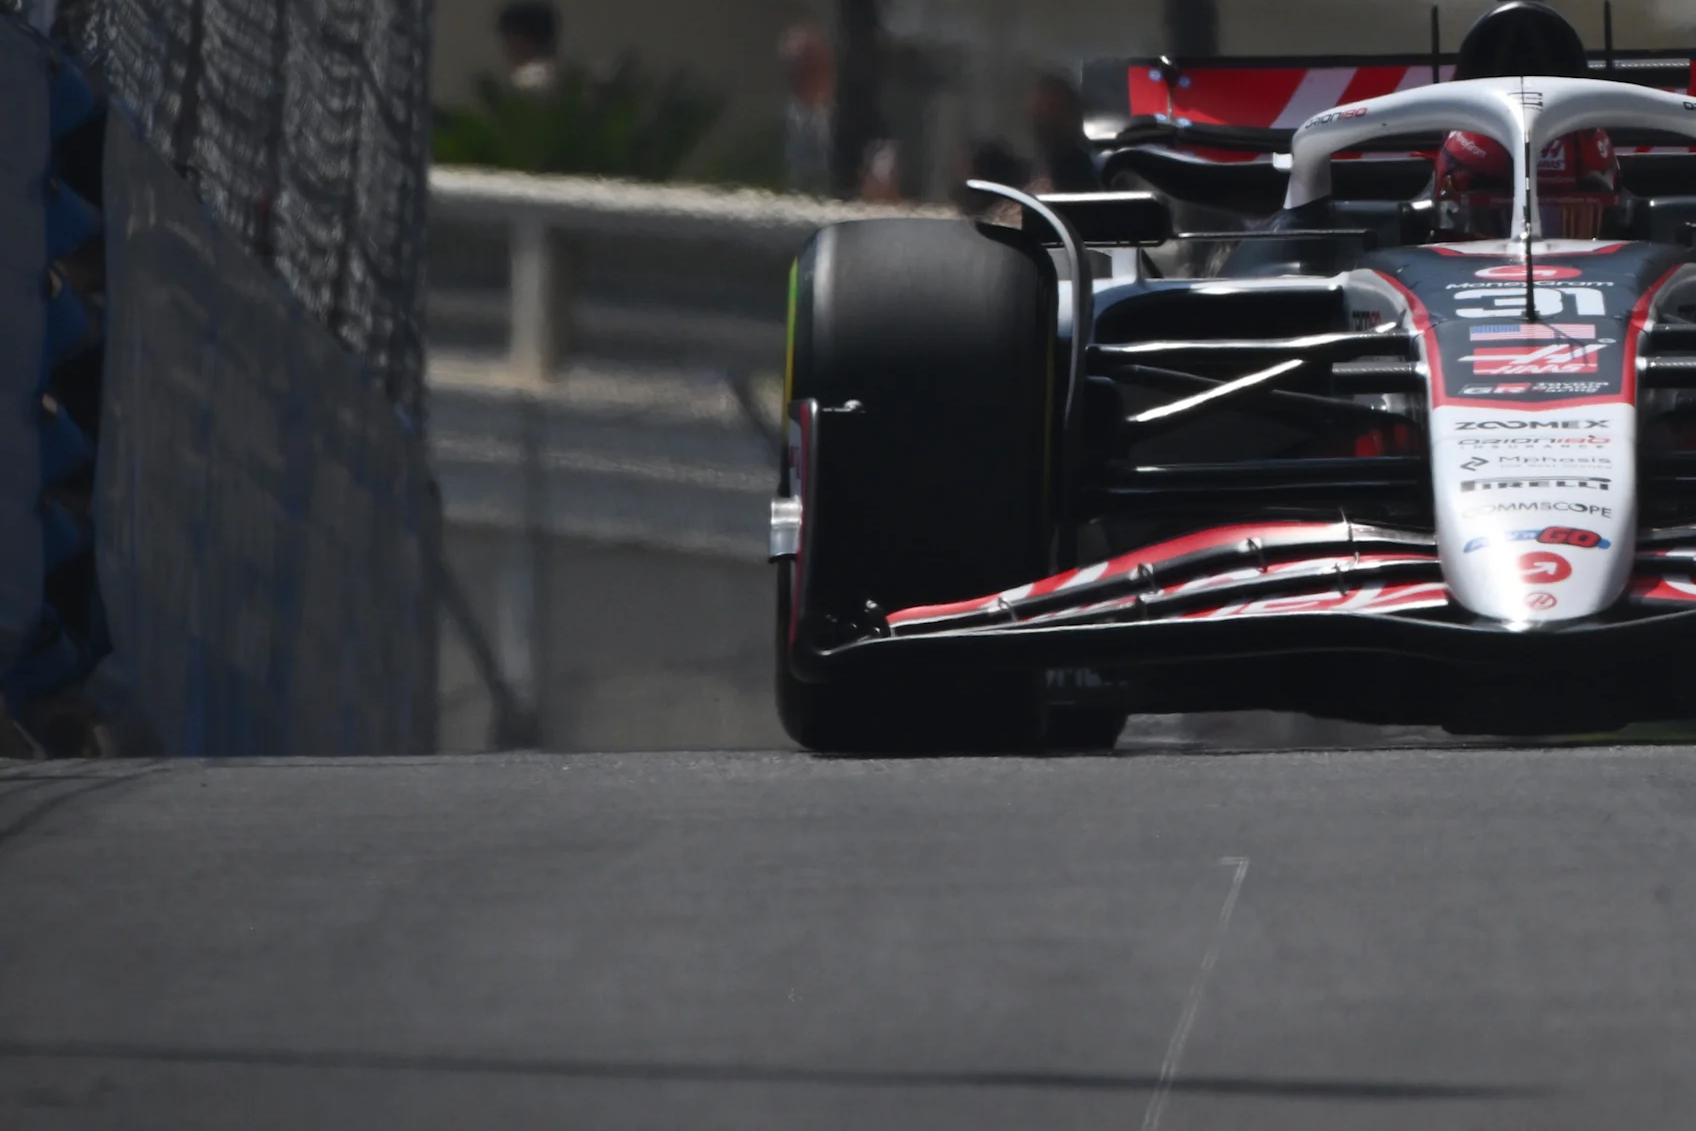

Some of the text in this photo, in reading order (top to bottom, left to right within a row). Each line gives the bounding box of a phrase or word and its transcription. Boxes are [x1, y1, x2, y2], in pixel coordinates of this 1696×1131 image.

[1445, 280, 1614, 289] MoneyGram
[1453, 287, 1606, 318] 31
[1455, 420, 1610, 430] ZOOMEX
[1499, 456, 1612, 464] Mphasis
[1460, 476, 1612, 493] PIRELLI
